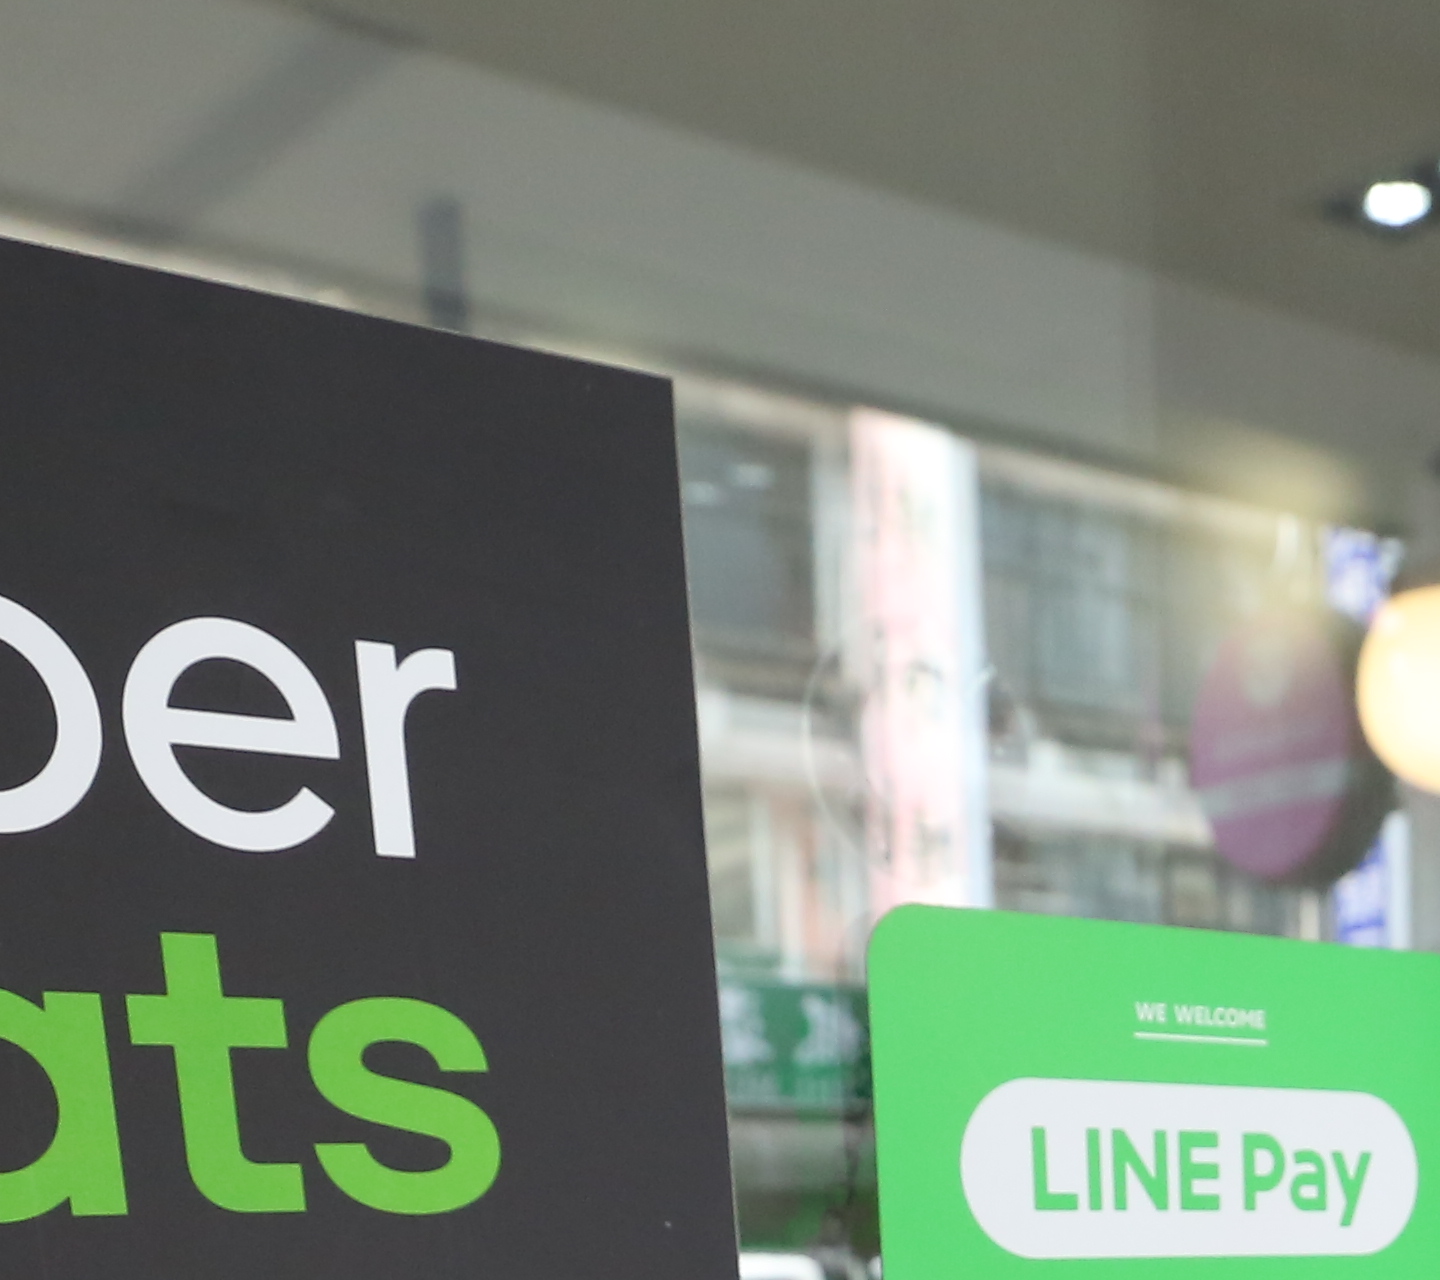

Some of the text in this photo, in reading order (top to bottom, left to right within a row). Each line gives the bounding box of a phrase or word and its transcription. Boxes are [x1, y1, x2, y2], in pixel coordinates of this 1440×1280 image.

[1135, 1001, 1266, 1031] WE WELCOME
[1030, 1125, 1372, 1227] LINE Pay
